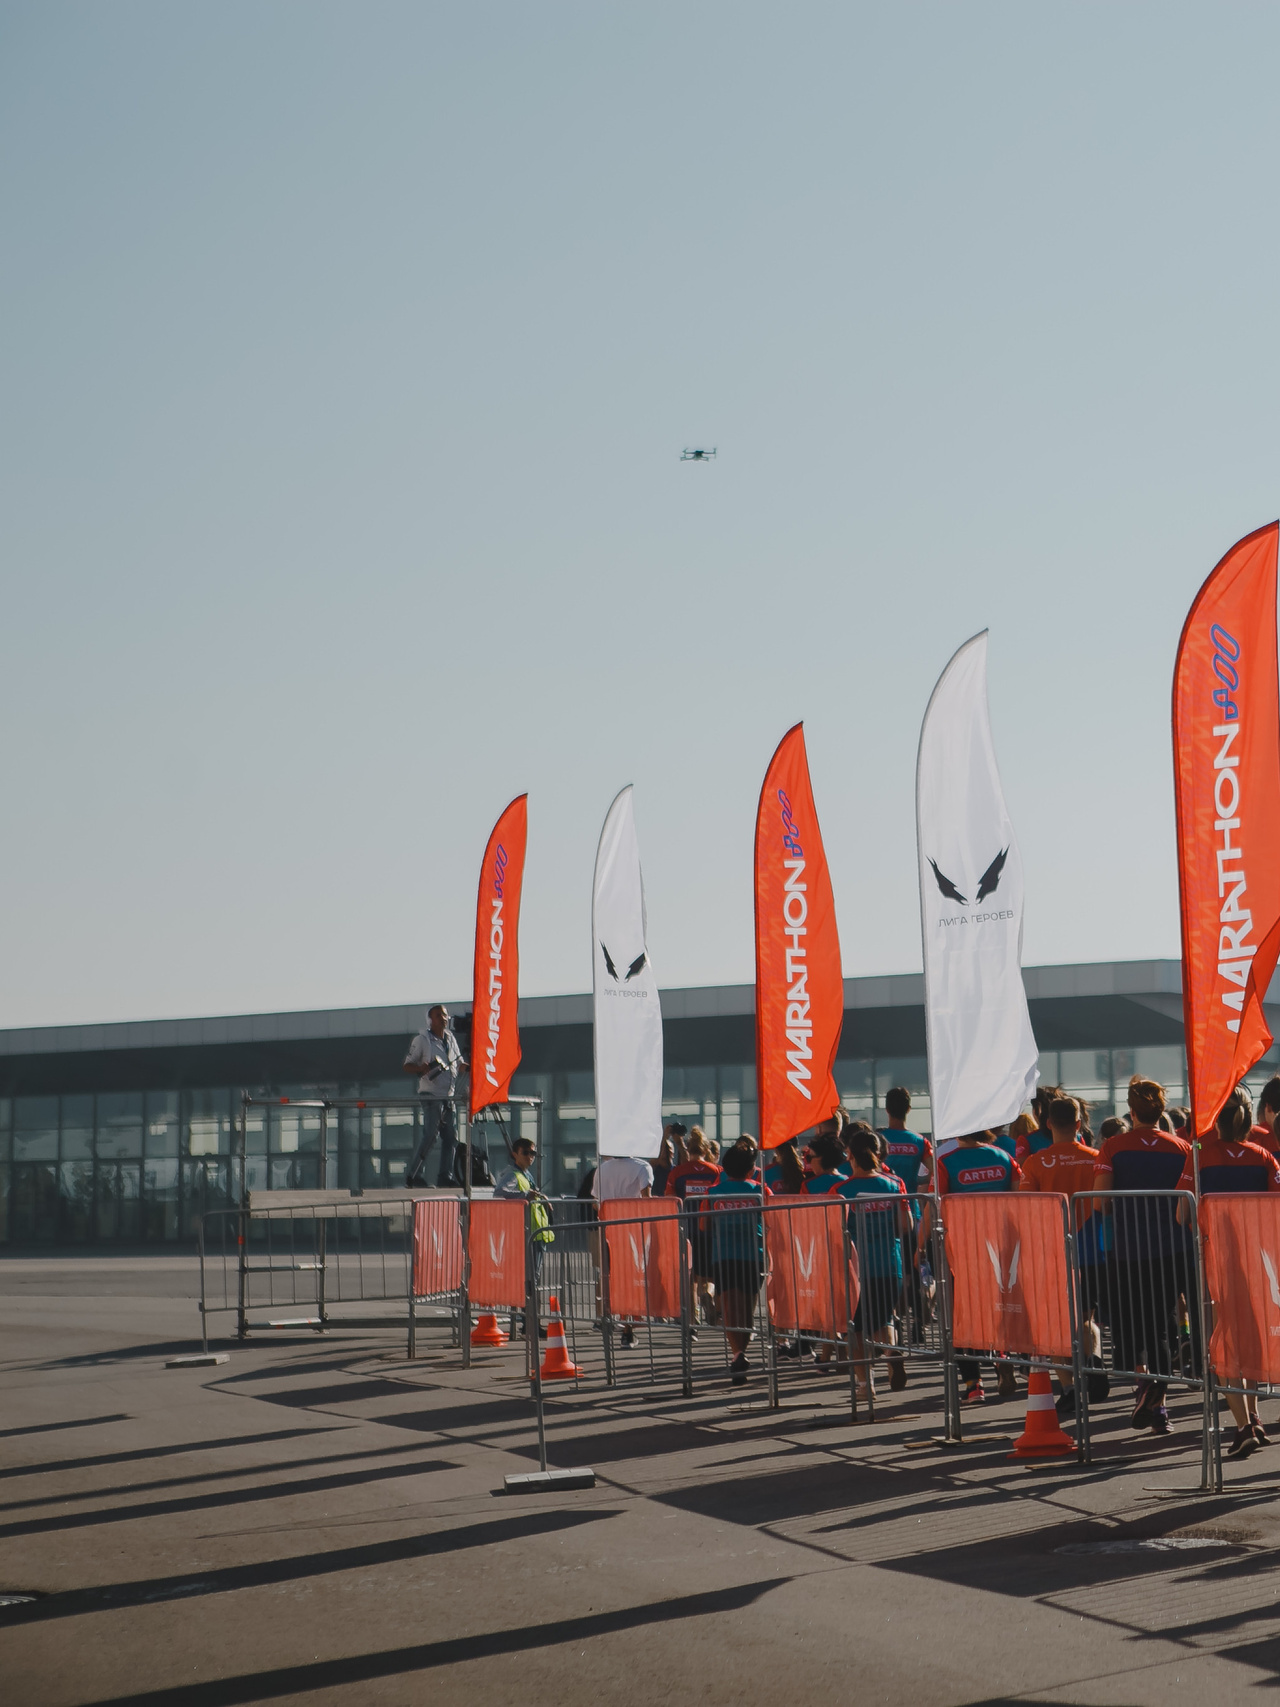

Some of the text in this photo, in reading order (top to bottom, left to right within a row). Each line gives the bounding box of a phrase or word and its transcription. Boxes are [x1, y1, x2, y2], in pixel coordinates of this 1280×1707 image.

[938, 910, 1015, 928] ЛИГА ГЕРОЕВ
[783, 858, 813, 1101] MARATHON
[485, 898, 504, 1088] MARATHON
[618, 989, 648, 998] ГЕРОЕВ
[890, 1145, 915, 1154] RTRA
[963, 1168, 1003, 1181] ARTRA
